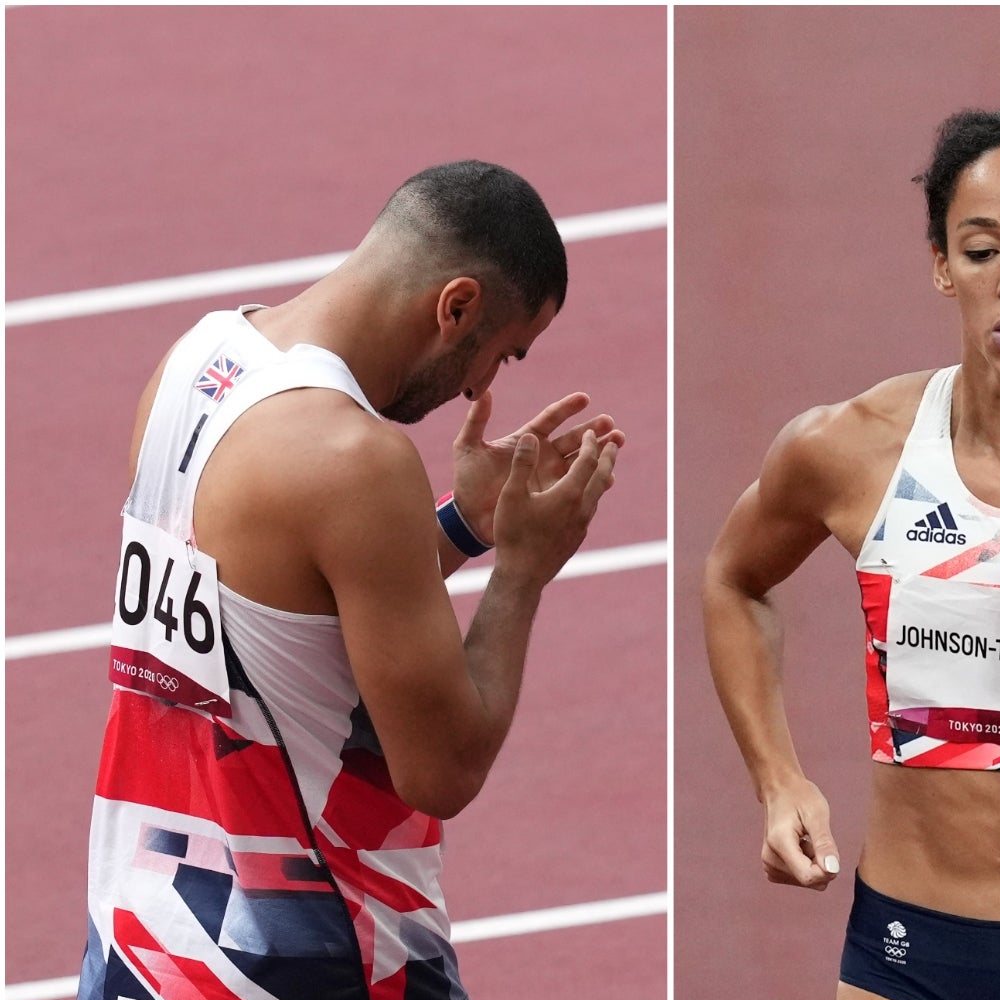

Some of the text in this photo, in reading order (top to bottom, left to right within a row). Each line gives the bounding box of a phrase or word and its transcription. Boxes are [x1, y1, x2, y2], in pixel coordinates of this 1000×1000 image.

[906, 527, 967, 546] adidas
[112, 658, 155, 683] TOKYO 2020
[948, 719, 983, 733] TOKYO
